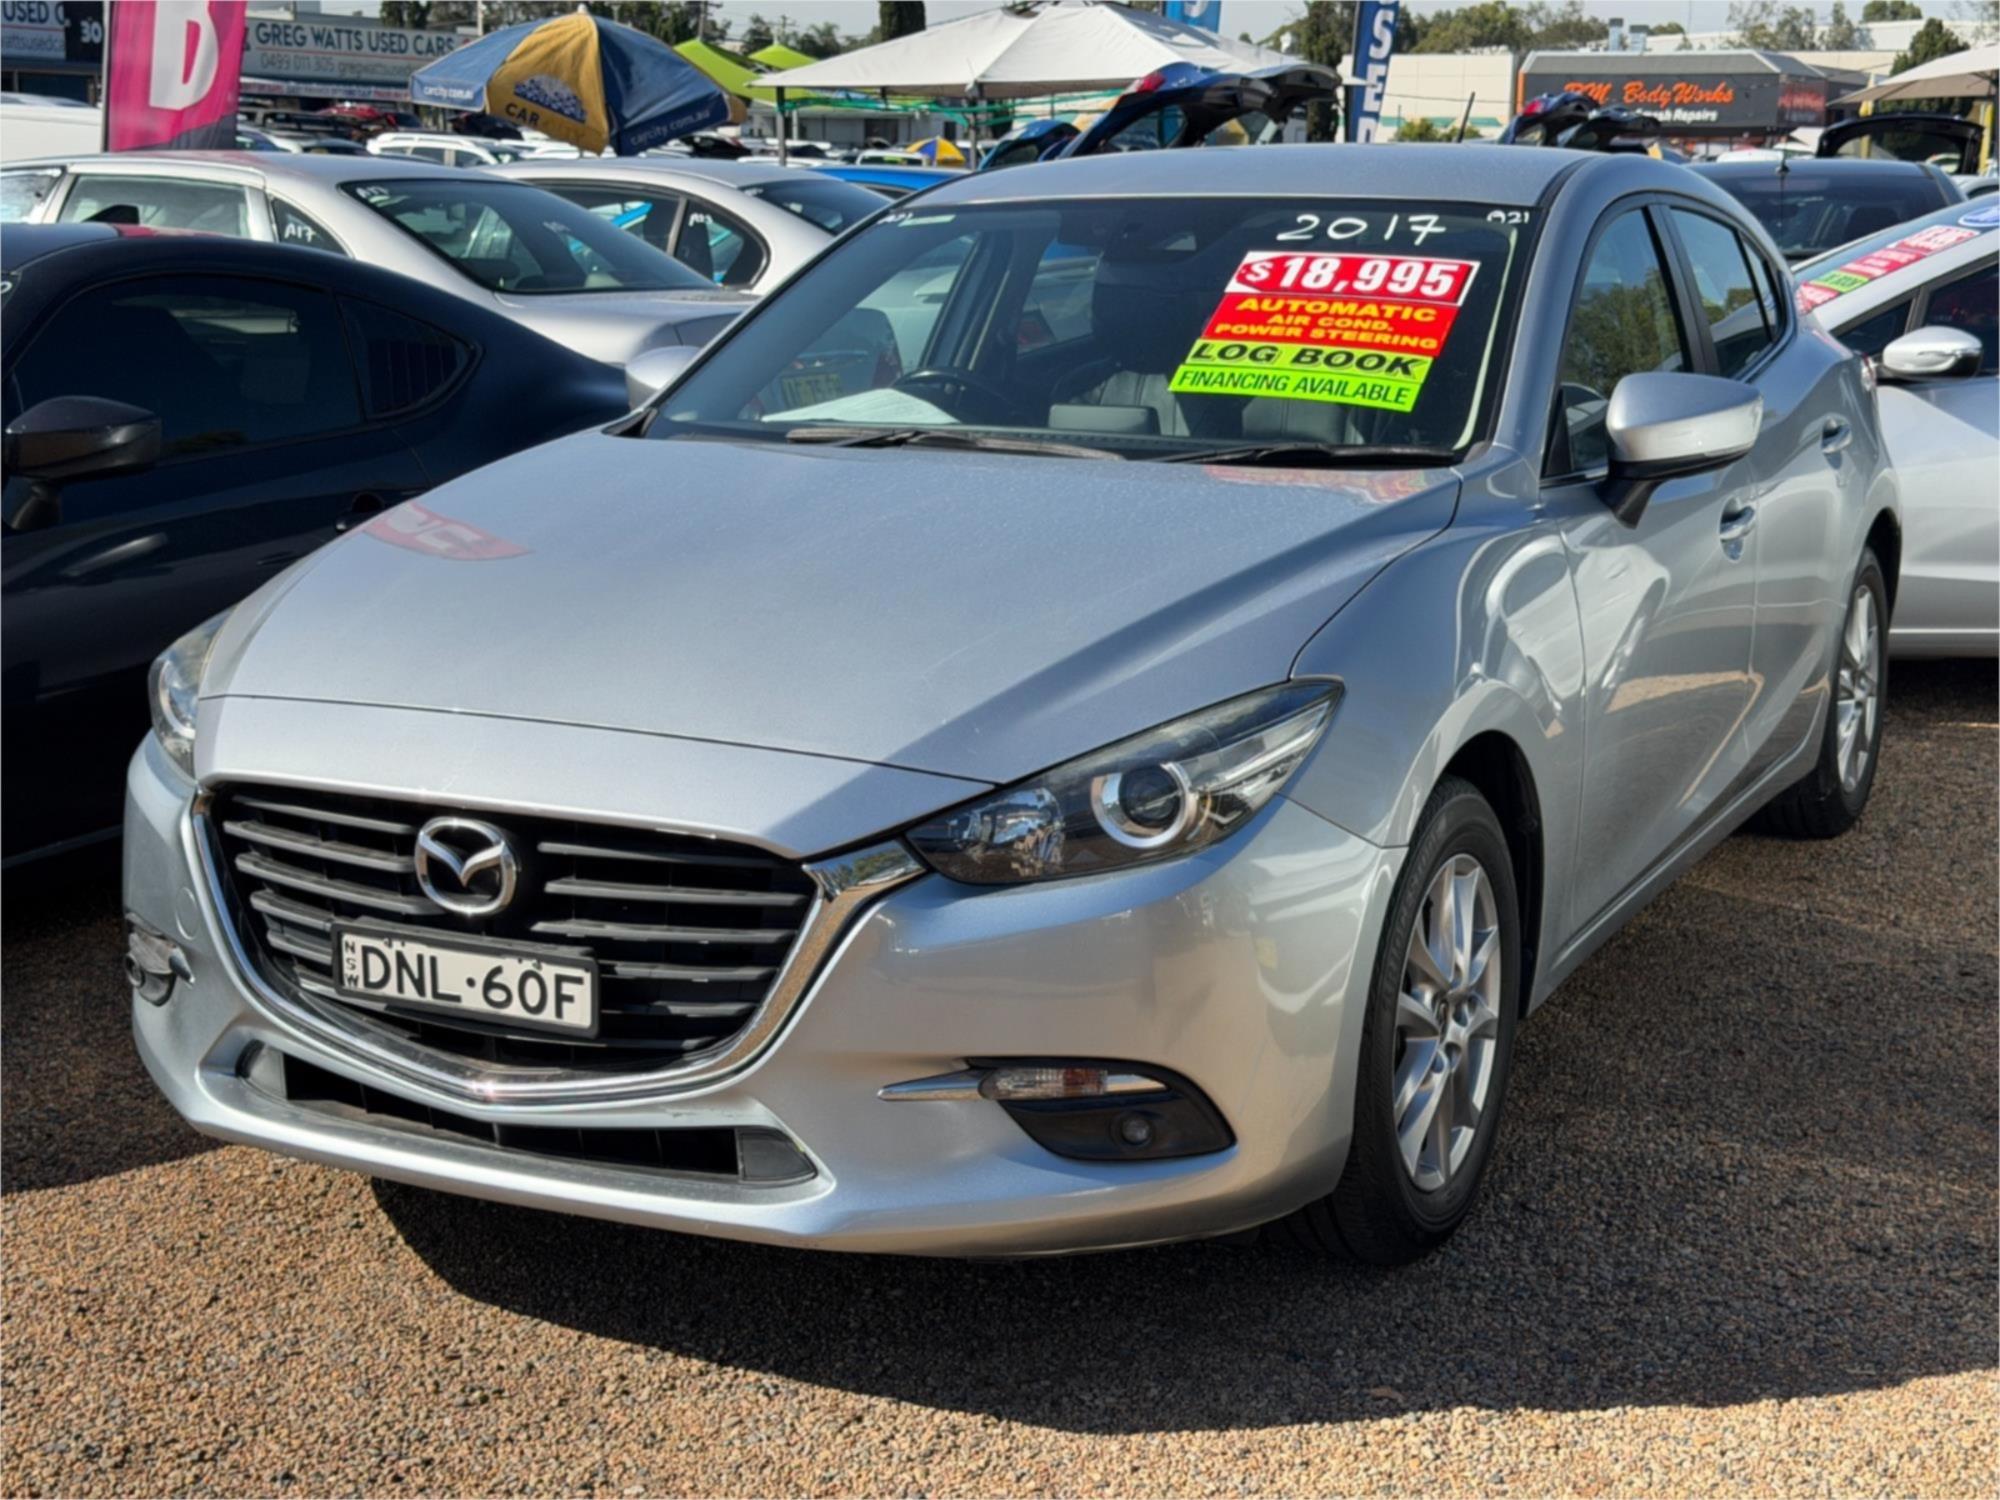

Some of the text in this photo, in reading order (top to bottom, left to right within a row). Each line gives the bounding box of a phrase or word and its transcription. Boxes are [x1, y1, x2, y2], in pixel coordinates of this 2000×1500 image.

[2, 1, 49, 23] USED
[80, 20, 102, 44] 30
[255, 22, 455, 55] GREG WATTS USED CARS
[261, 53, 291, 69] 0499
[293, 55, 311, 70] 011
[505, 102, 540, 125] CAR
[1673, 108, 1717, 124] Repairs
[284, 223, 318, 243] A17
[1276, 213, 1447, 247] 2017
[1235, 298, 1437, 322] AUTOMATIC
[1267, 313, 1393, 332] AIR COND.
[1215, 324, 1438, 350] POWER STEERING
[1191, 343, 1426, 380] LOG BOOK
[1178, 370, 1411, 406] FINANCING AVAILABLE
